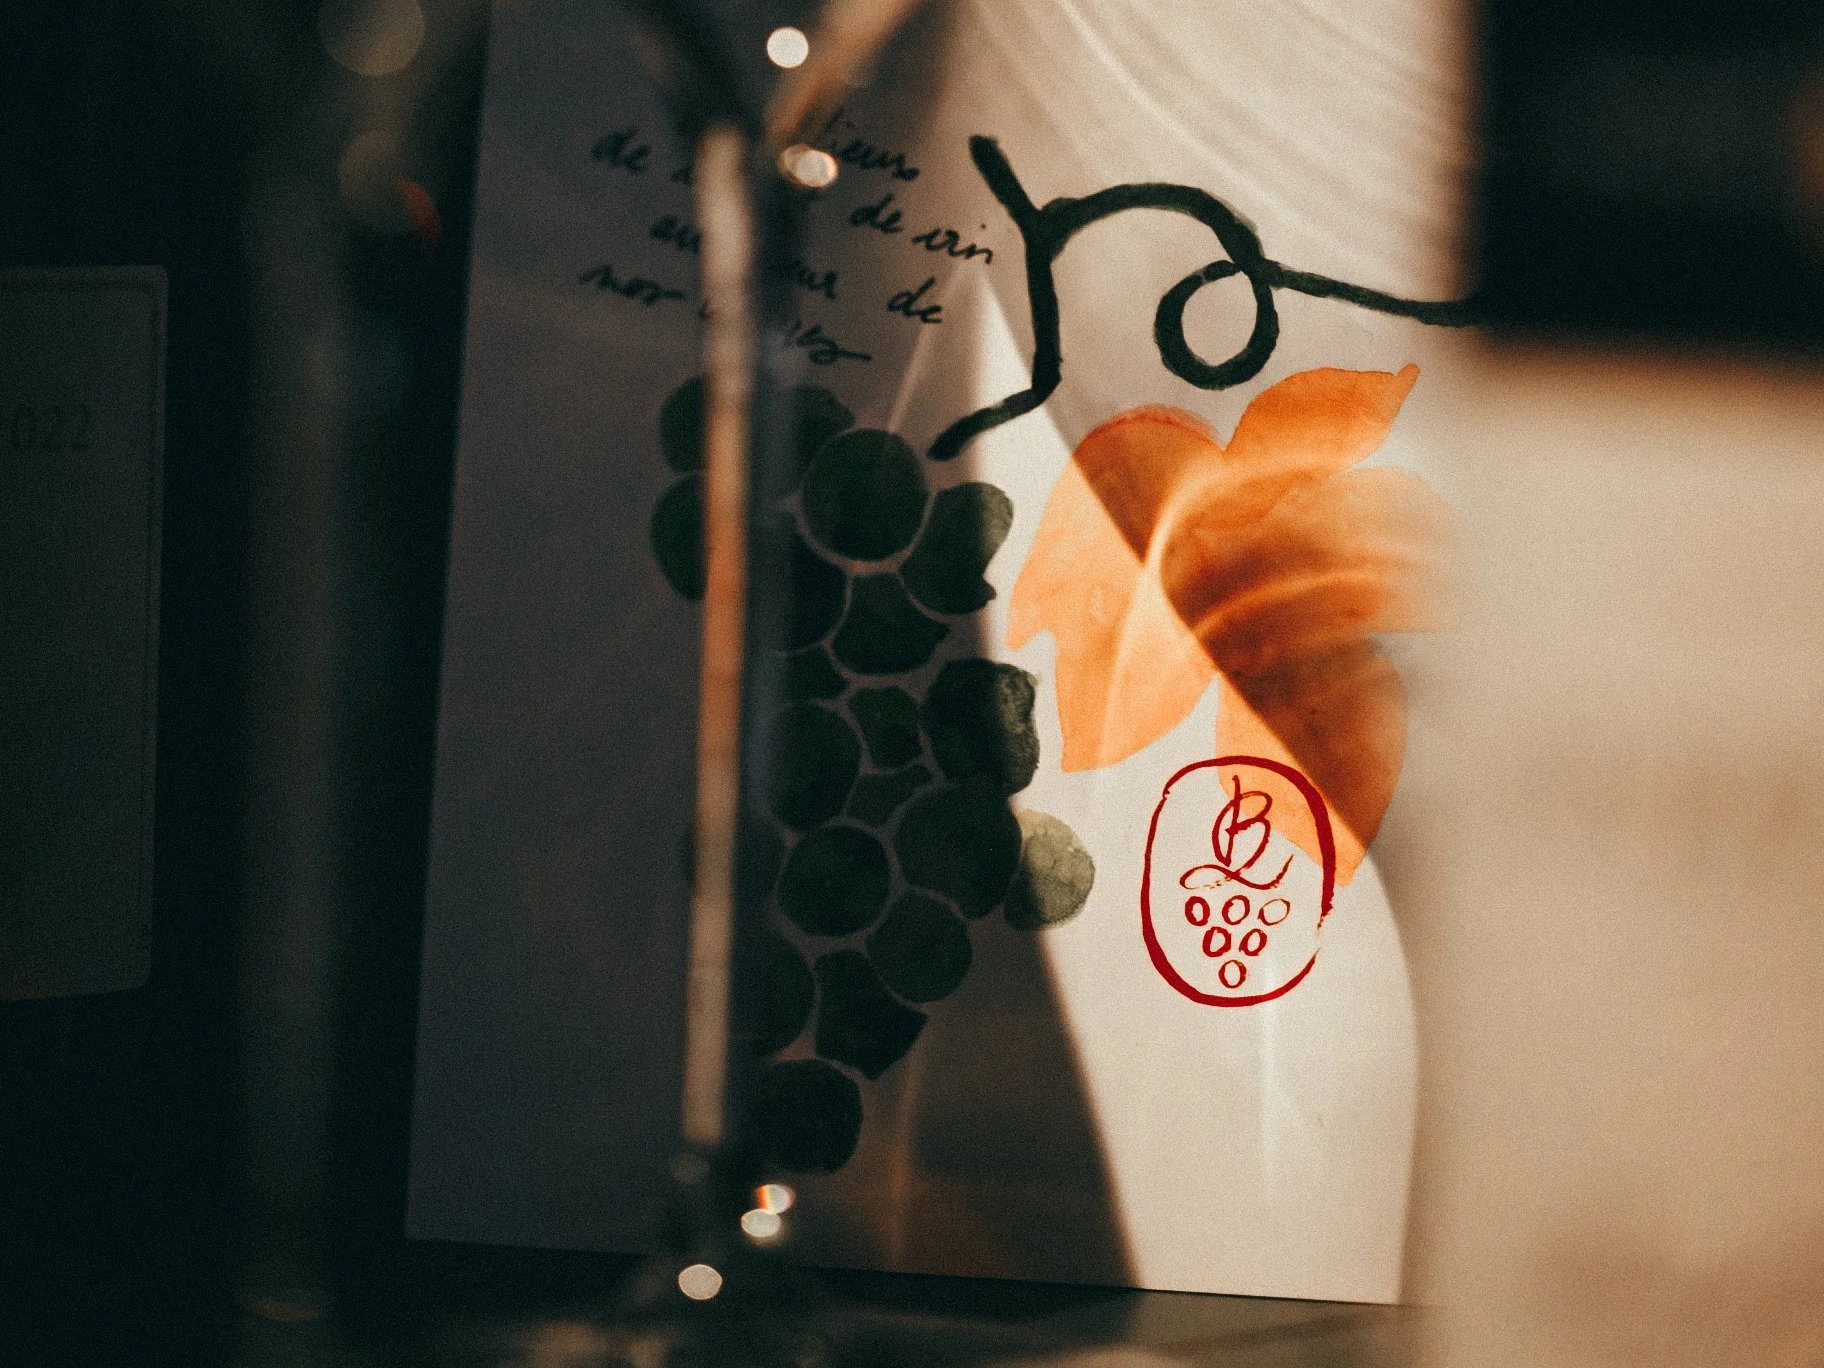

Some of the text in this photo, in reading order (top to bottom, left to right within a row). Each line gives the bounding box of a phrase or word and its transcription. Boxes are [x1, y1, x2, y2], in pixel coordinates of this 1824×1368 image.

[850, 194, 904, 234] de
[912, 222, 992, 264] vin
[887, 277, 944, 324] de
[4, 403, 92, 454] 022
